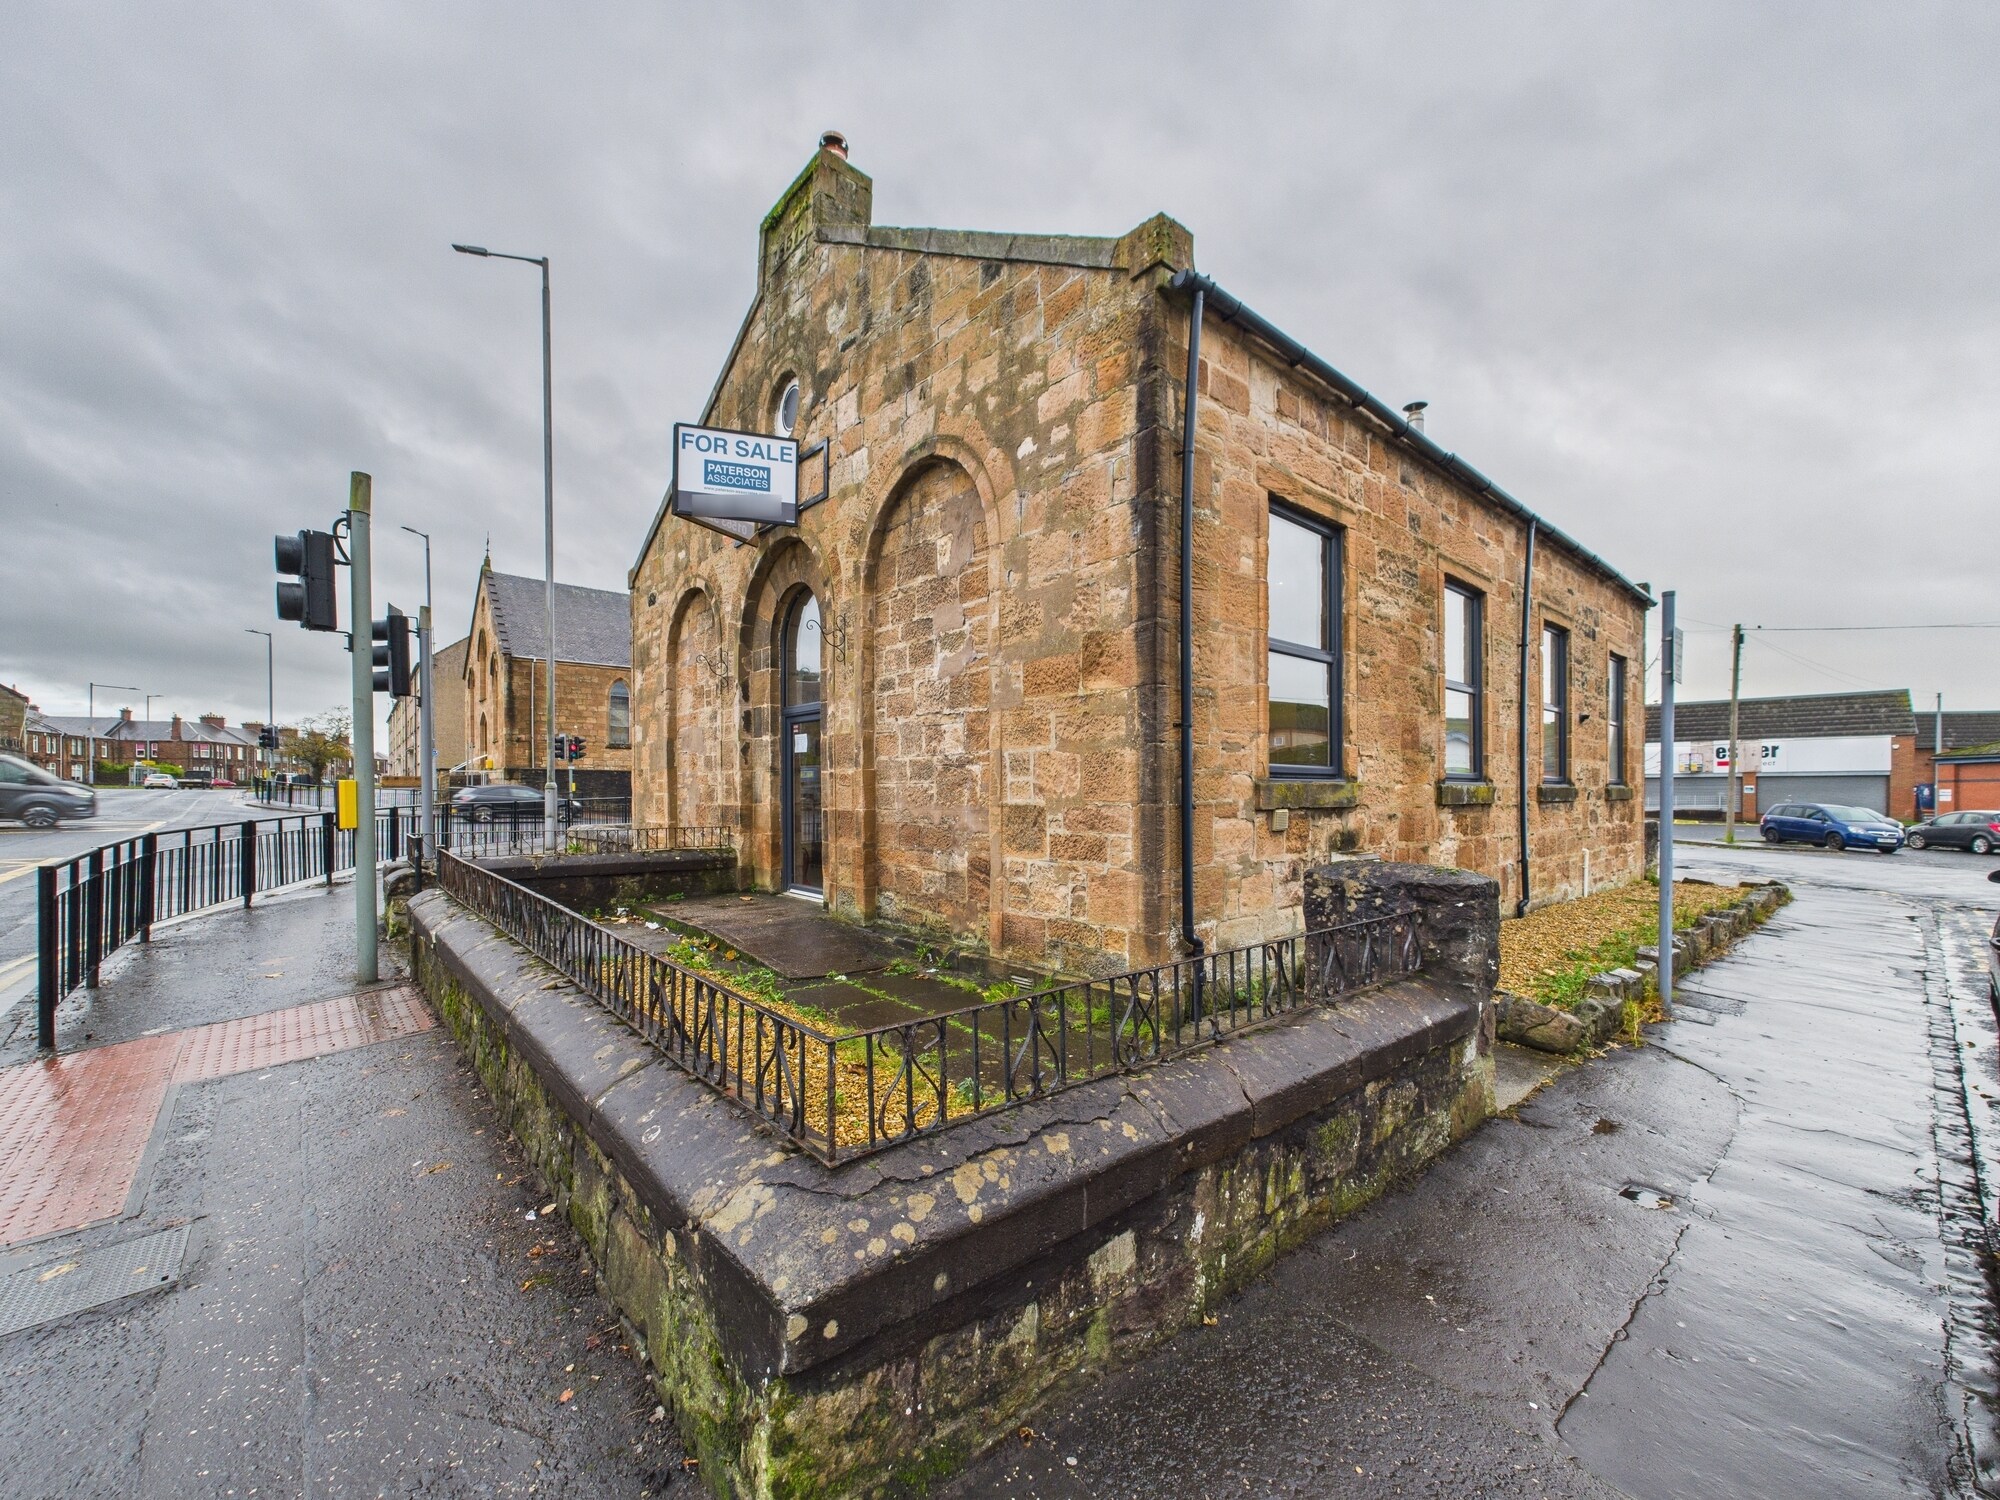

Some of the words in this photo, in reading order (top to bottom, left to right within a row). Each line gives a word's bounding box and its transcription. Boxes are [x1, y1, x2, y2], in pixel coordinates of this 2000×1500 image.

[681, 432, 728, 455] FOR
[735, 440, 793, 463] SALE
[708, 463, 767, 479] PATERSON
[707, 474, 768, 489] ASSOCIATES
